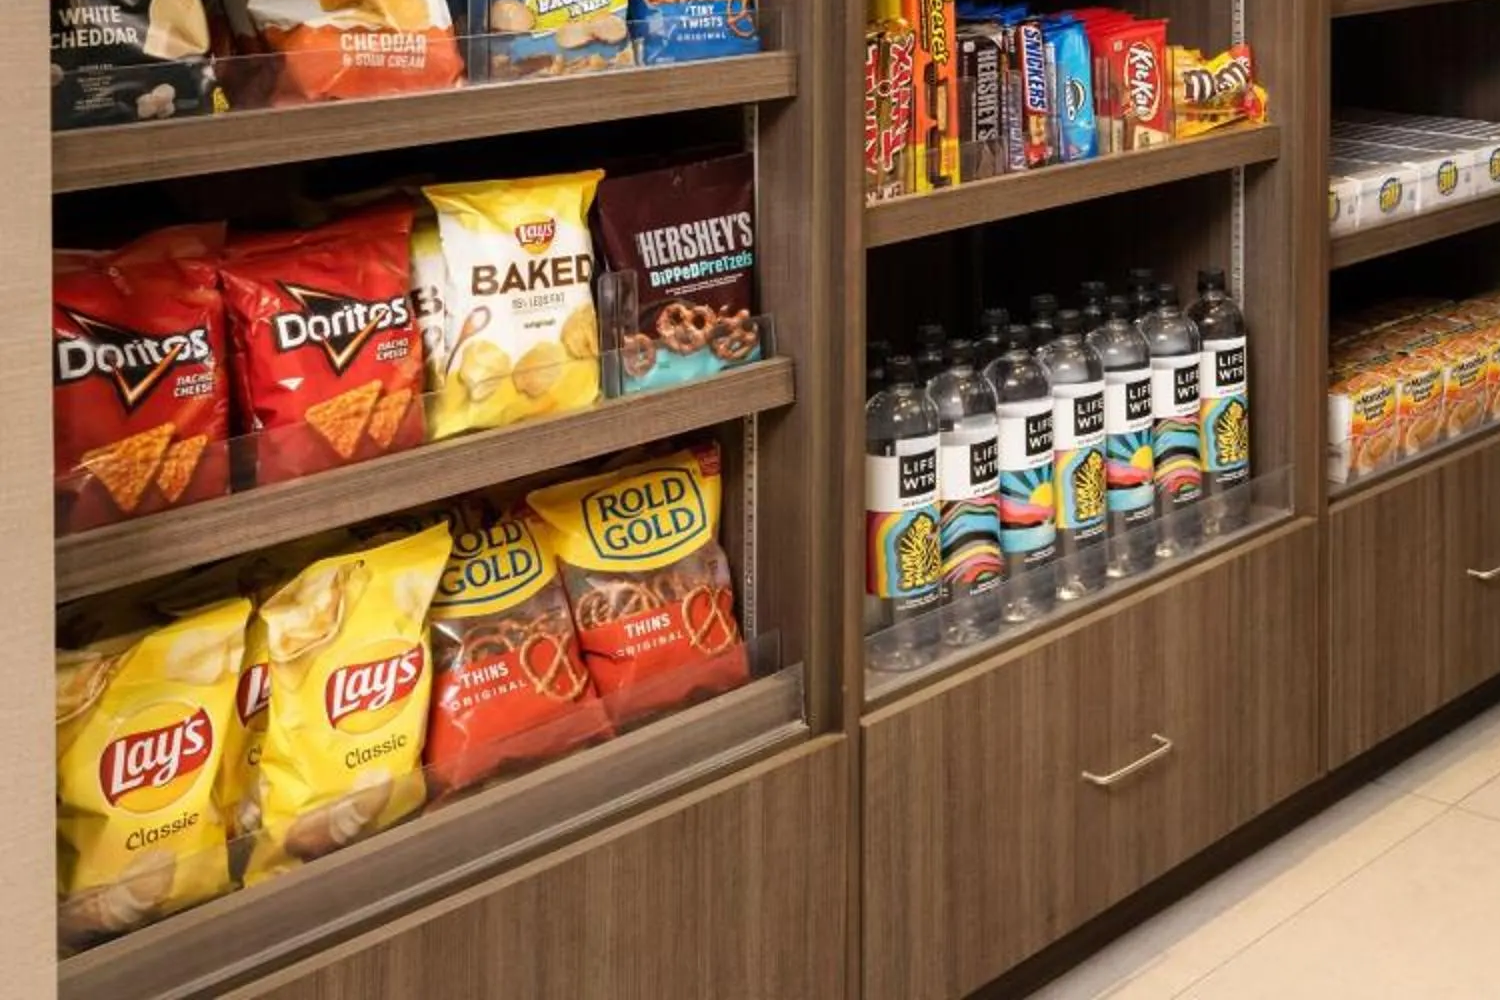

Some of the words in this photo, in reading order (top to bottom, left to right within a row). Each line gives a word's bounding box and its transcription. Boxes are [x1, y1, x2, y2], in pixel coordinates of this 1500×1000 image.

[60, 4, 123, 26] WHITE
[679, 15, 724, 30] TWISTS
[50, 25, 139, 51] CHEDDAR
[340, 32, 427, 54] CHEDDAR
[386, 53, 426, 69] CREAM
[1023, 26, 1046, 110] SNICKERS
[977, 47, 1000, 141] HERSHEY'S
[518, 219, 555, 245] Lay's
[637, 211, 753, 269] HERSHEY'S
[471, 254, 594, 297] BAKED
[275, 296, 409, 350] Doritos
[59, 328, 210, 381] Doritos
[1218, 350, 1244, 367] LIFE
[903, 456, 935, 475] LIFE
[597, 476, 685, 522] ROLD
[449, 519, 524, 559] OLD
[603, 507, 695, 552] GOLD
[439, 547, 533, 597] GOLD
[616, 630, 685, 659] ORIGINAL
[624, 612, 671, 639] THINS
[331, 650, 423, 721] Lay's
[460, 660, 509, 690] THINS
[449, 678, 528, 713] ORIGINAL
[110, 714, 207, 797] Lay's
[344, 733, 408, 770] Classic
[125, 810, 199, 852] Classic
